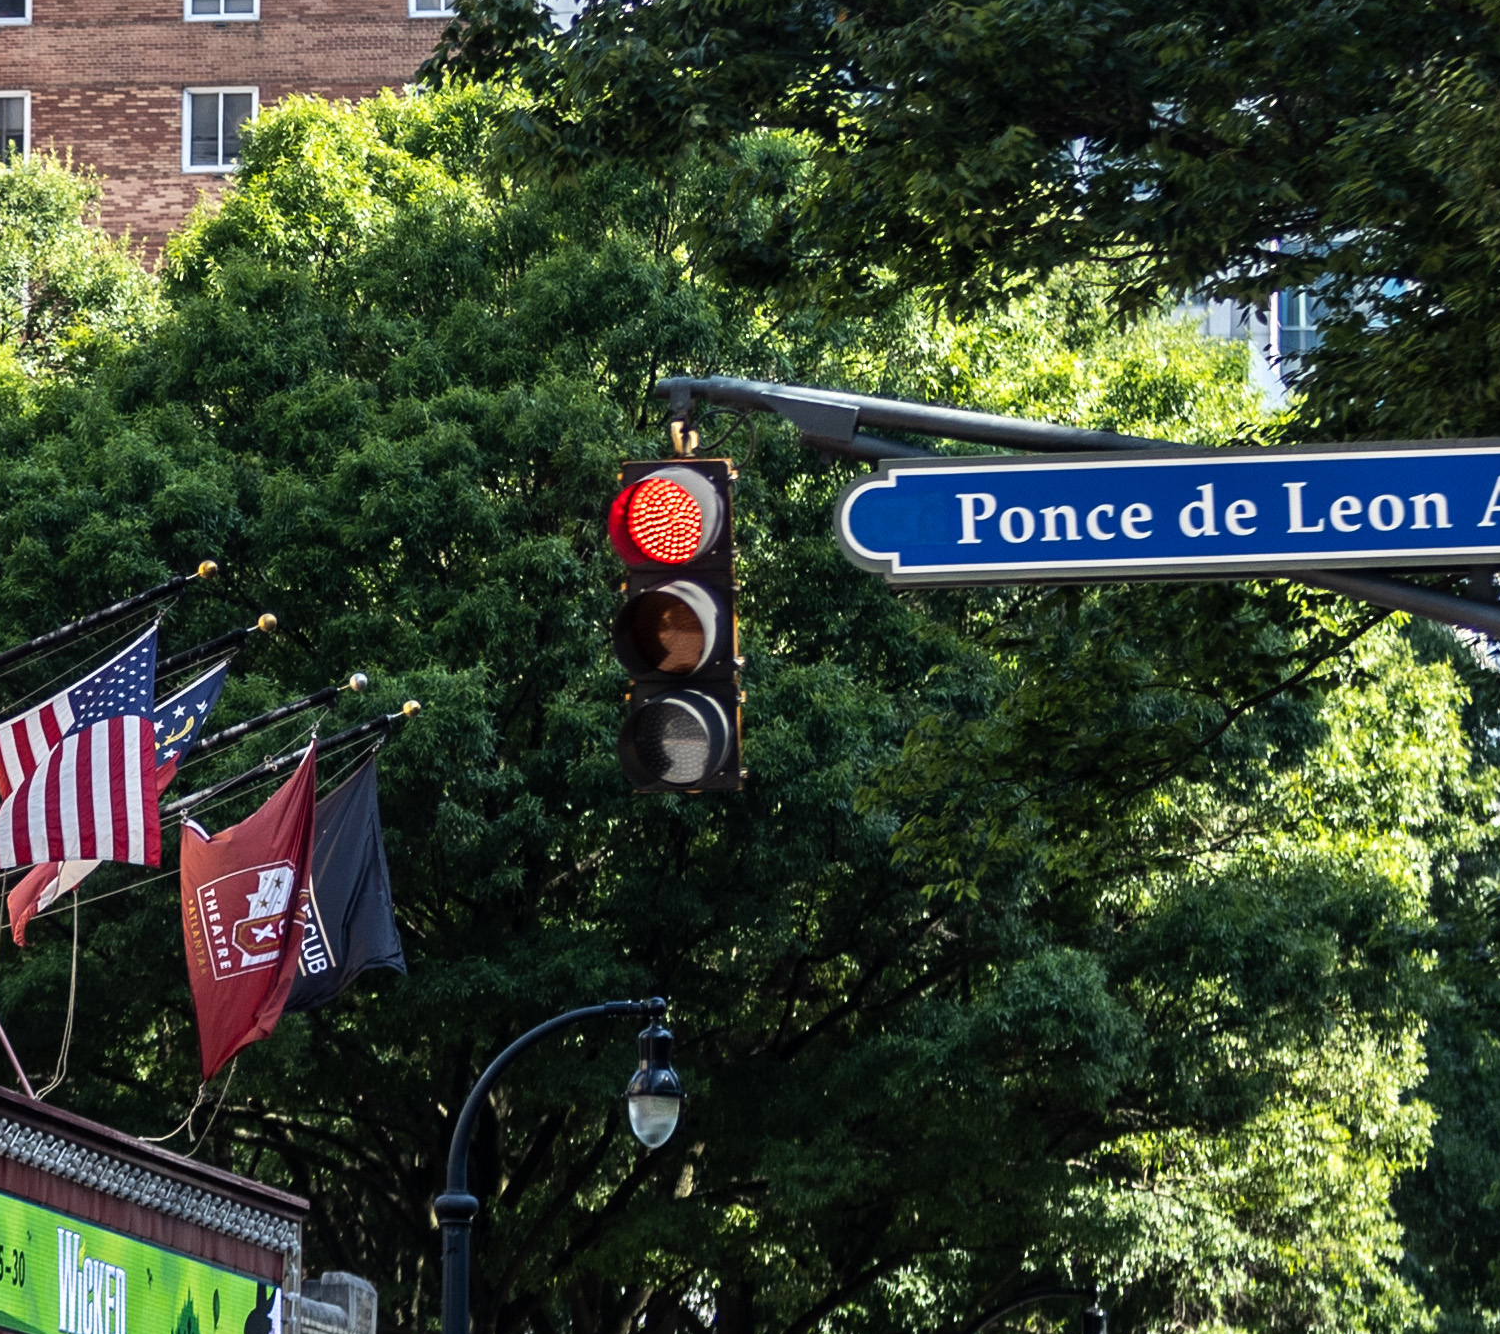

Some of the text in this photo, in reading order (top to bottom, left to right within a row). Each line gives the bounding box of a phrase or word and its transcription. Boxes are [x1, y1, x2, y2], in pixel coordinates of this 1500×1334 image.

[956, 491, 1154, 545] Ponce
[1178, 482, 1258, 538] de
[1285, 479, 1454, 534] Leon
[203, 887, 233, 971] THEATRE
